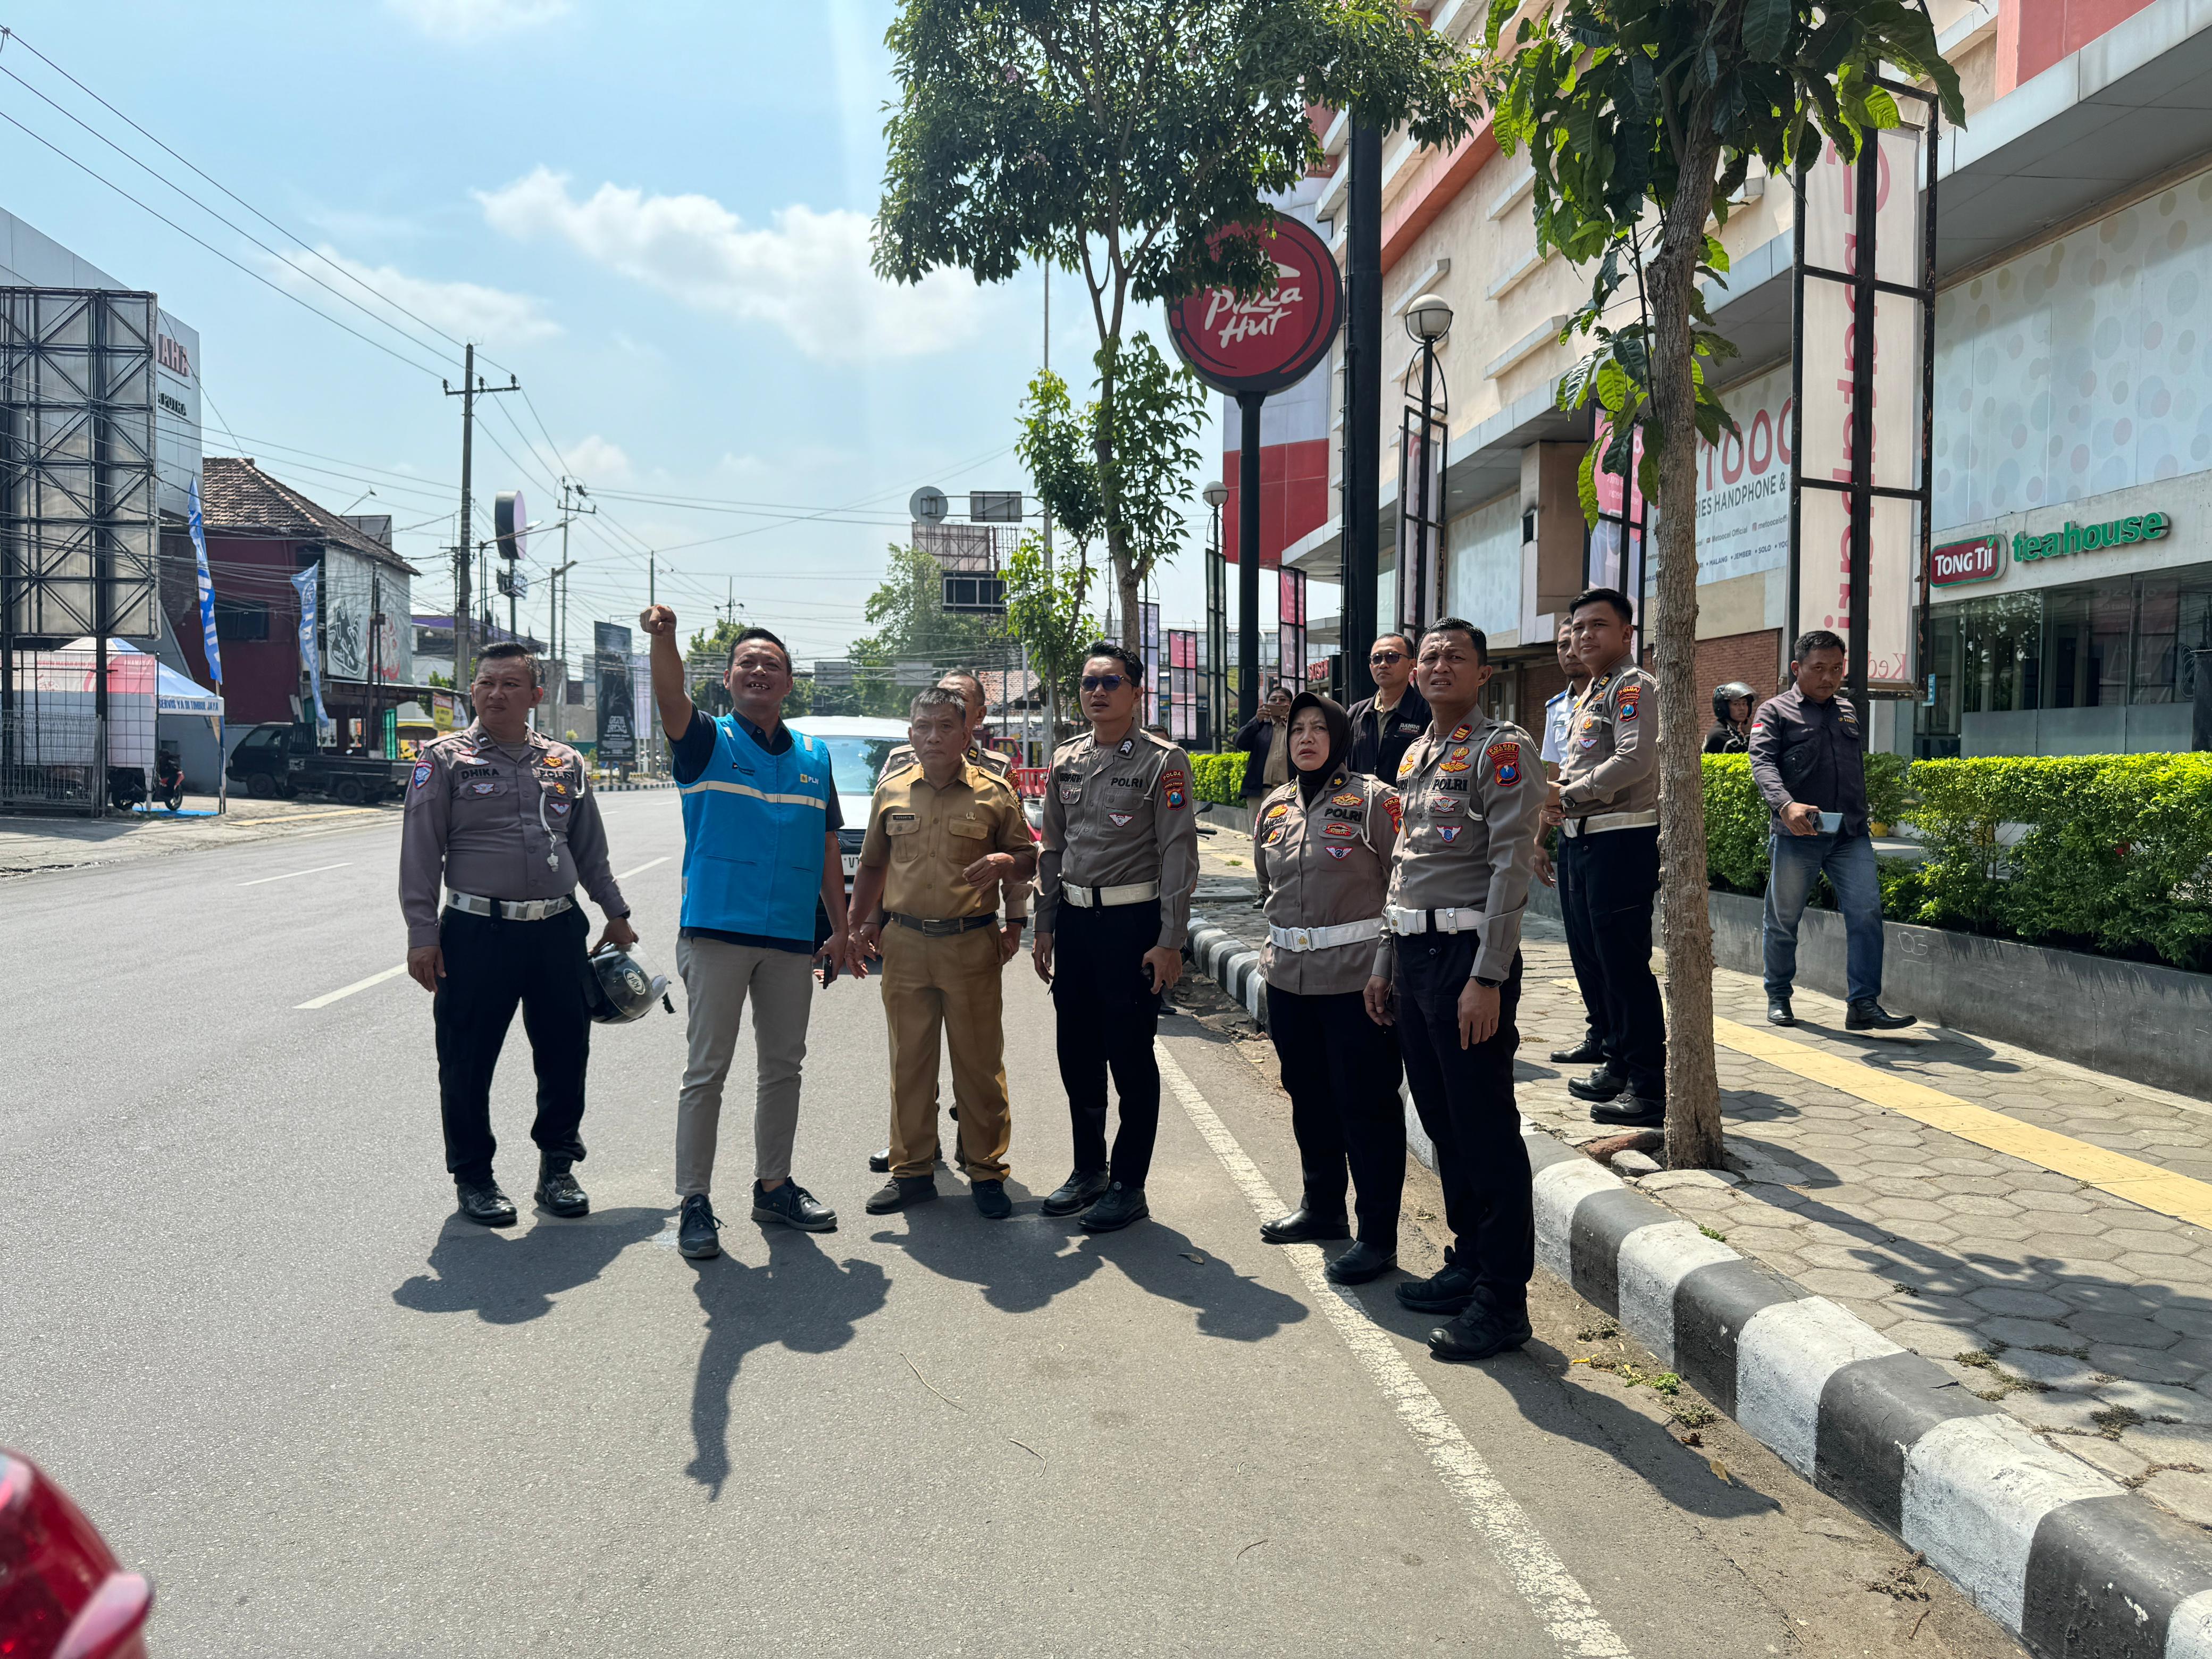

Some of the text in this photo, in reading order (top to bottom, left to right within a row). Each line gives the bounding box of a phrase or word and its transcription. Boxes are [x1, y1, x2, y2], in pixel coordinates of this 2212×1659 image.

[1204, 287, 1303, 330] Pizza
[1218, 307, 1292, 348] Hut
[157, 333, 189, 377] AHA
[164, 395, 187, 416] PUTRA
[1714, 474, 1776, 513] HANDPHONE
[1779, 472, 1786, 492] &
[1732, 526, 1748, 537] Official
[1758, 514, 1788, 530] metooceloffi
[2012, 512, 2169, 563] teahouse
[1709, 556, 1728, 566] MALANG
[1734, 550, 1752, 560] JEMBER
[1758, 545, 1771, 554] SOLO
[1934, 552, 1973, 576] TONG
[207, 701, 219, 711] JAYA
[1489, 744, 1515, 752] POLRES
[461, 768, 500, 780] DHIKA
[539, 769, 575, 779] POLRI
[1163, 771, 1181, 781] POLDA
[1110, 777, 1143, 789] POLRI
[1432, 777, 1468, 791] POLRI
[1384, 799, 1398, 807] POLD
[1324, 808, 1362, 822] POLRI
